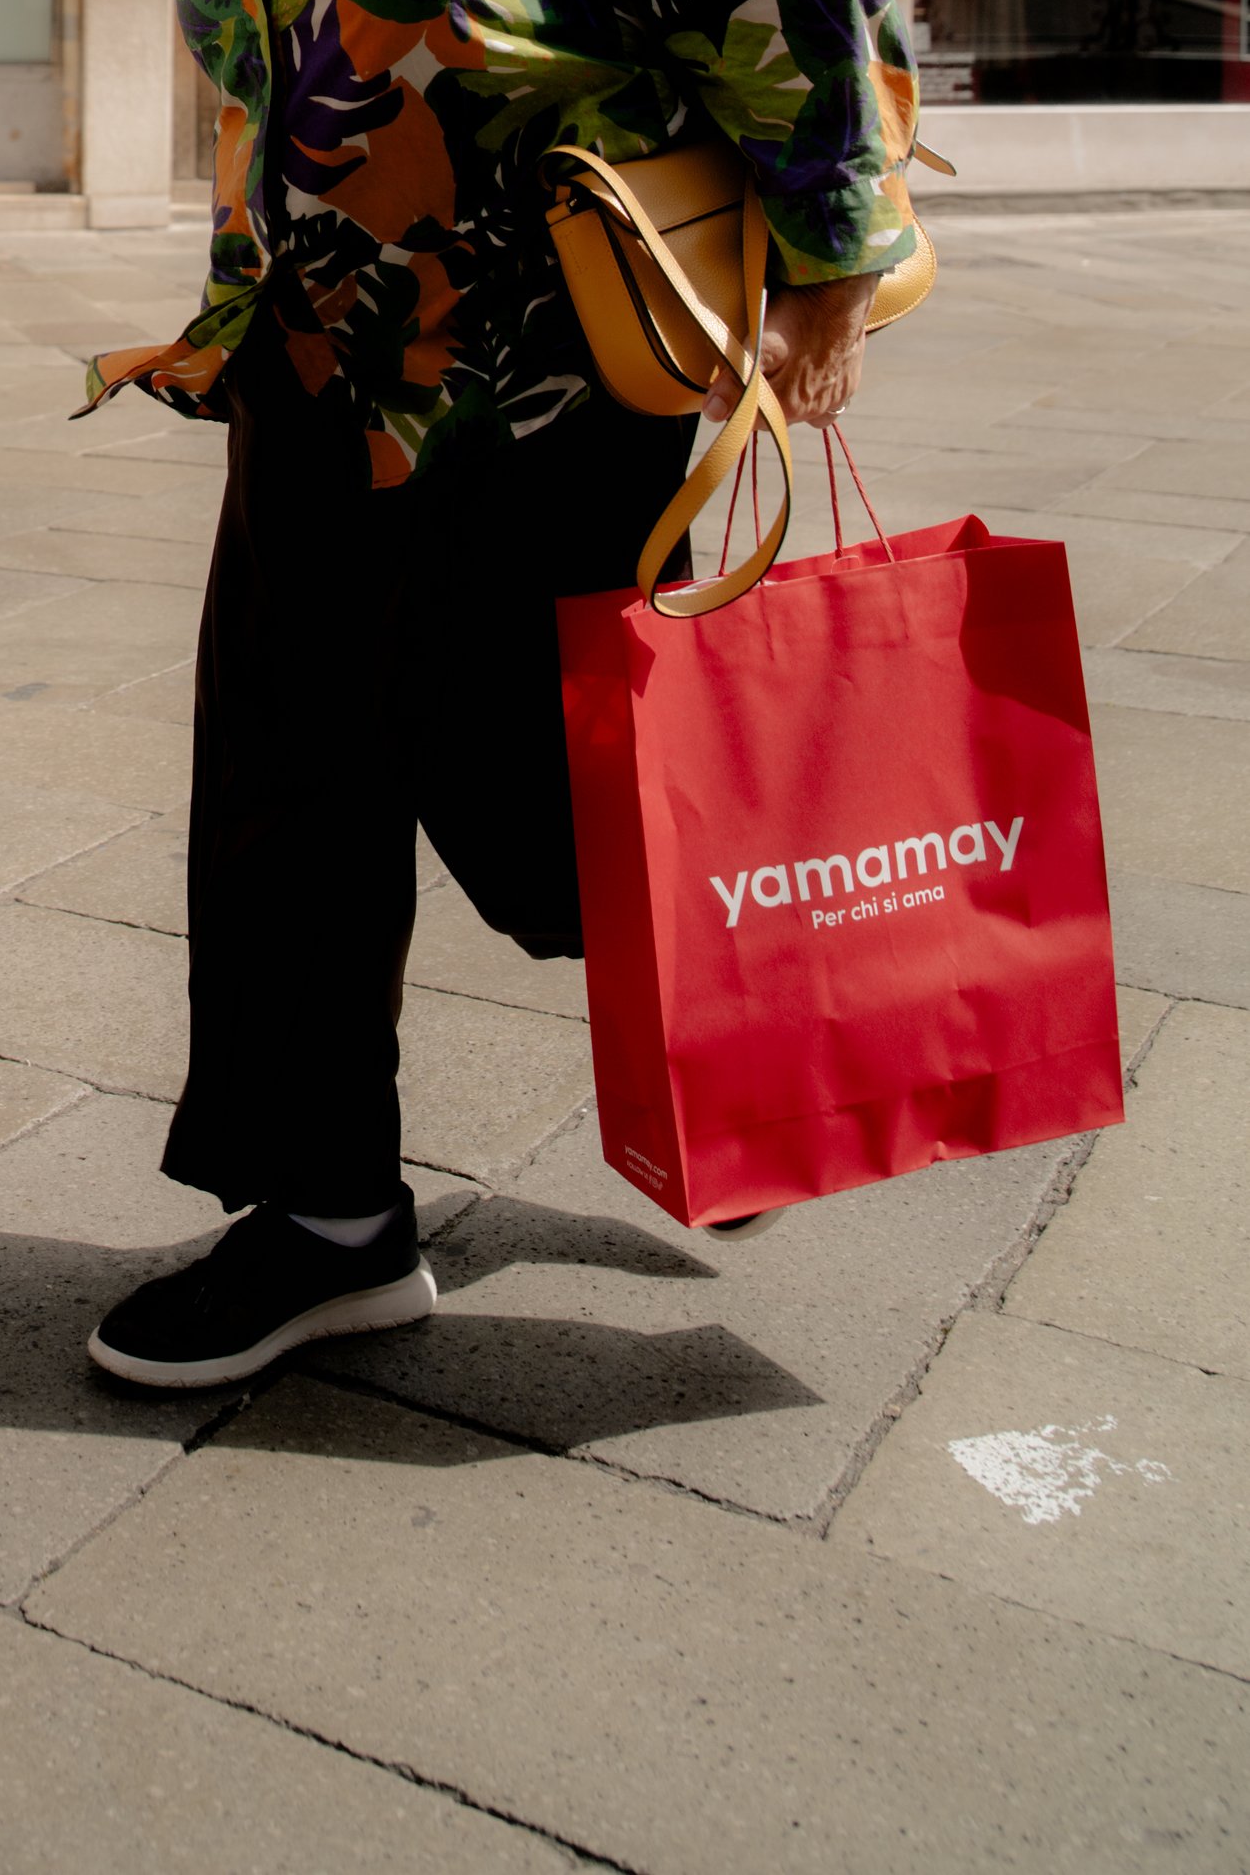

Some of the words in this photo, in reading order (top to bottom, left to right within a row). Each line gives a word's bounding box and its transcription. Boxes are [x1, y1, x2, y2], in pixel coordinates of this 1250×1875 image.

[709, 816, 1024, 929] yamamay
[811, 909, 846, 929] Per
[851, 895, 879, 921] chi
[883, 891, 898, 913] si
[902, 885, 945, 906] ama
